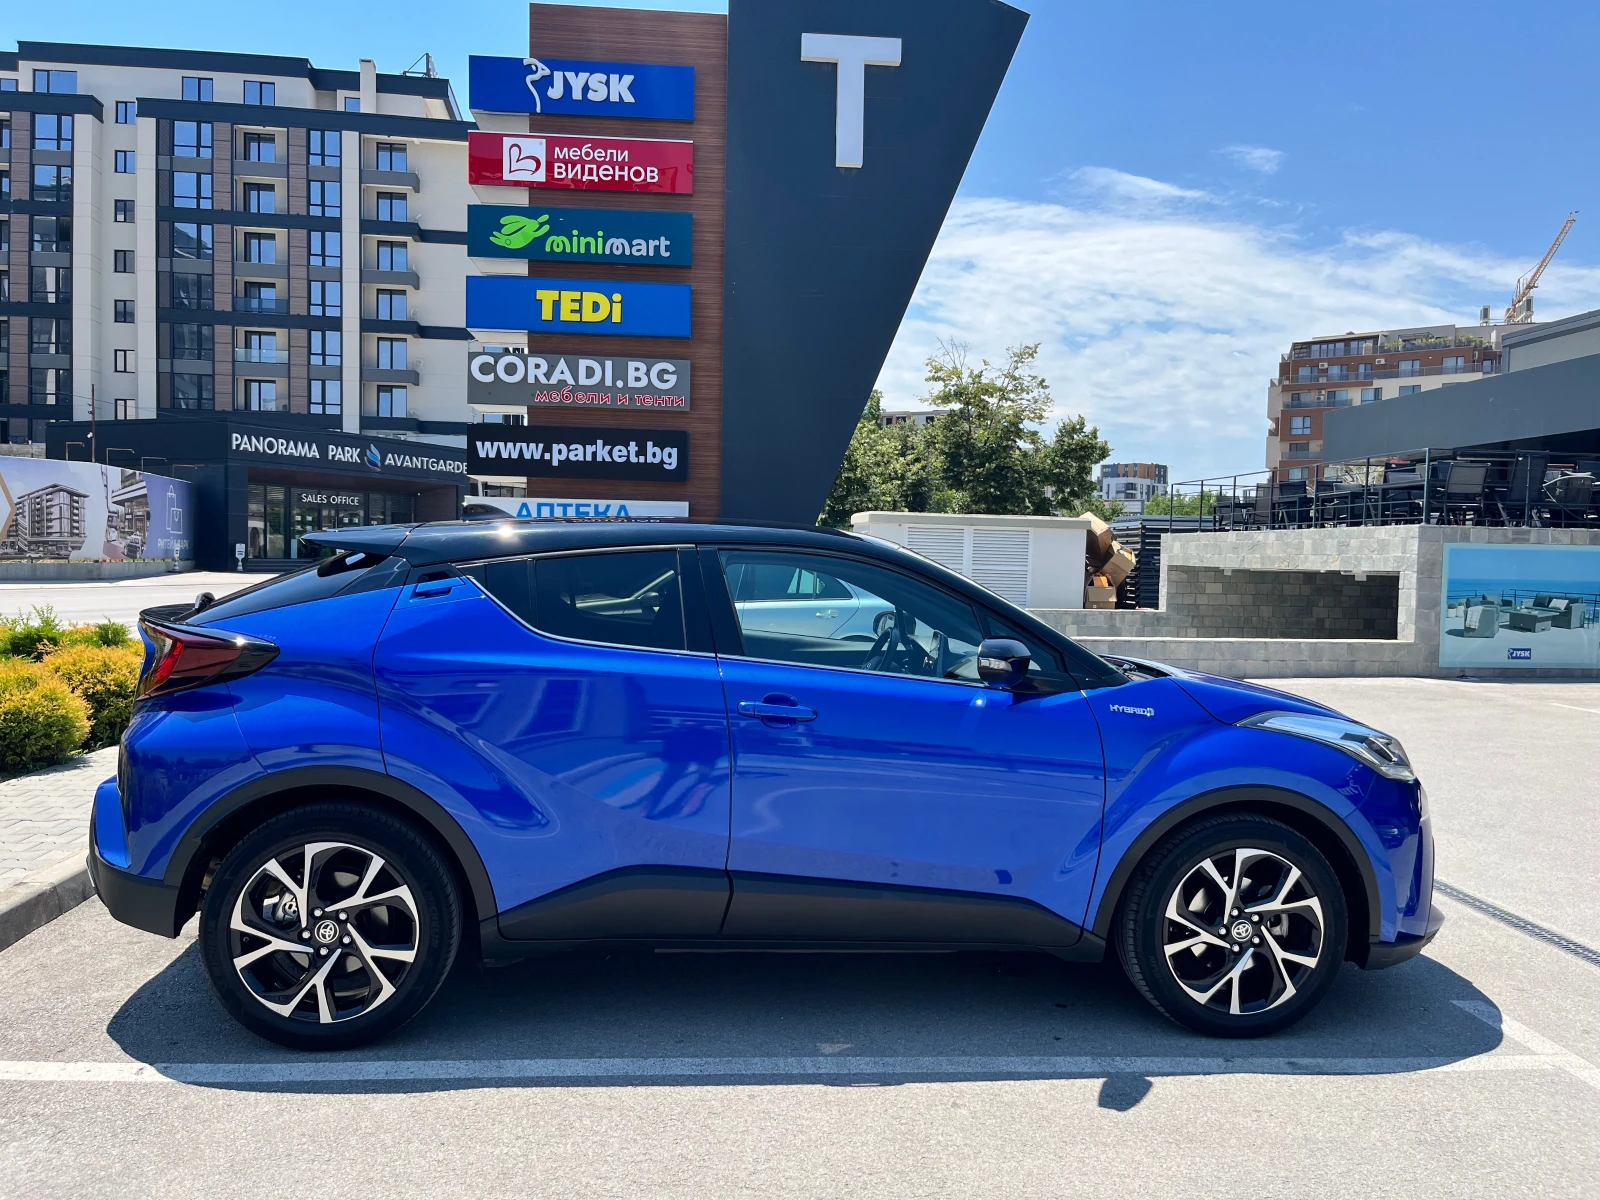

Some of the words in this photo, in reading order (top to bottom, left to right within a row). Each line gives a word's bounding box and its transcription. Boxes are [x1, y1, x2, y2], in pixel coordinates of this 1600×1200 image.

[547, 71, 635, 103] JYSK
[800, 33, 902, 169] T
[554, 143, 629, 163] мебели
[545, 229, 671, 257] minimart
[535, 289, 623, 323] TEDi
[470, 354, 678, 390] CORADI.BG
[534, 385, 611, 405] мебели
[617, 393, 629, 405] и
[635, 394, 685, 407] тенти
[231, 433, 320, 459] PANORAMA
[328, 444, 361, 463] PARK
[475, 440, 678, 470] www.parket.bg
[301, 493, 327, 504] SALES
[330, 495, 360, 506] OFFICE
[1109, 704, 1148, 716] HYBRID
